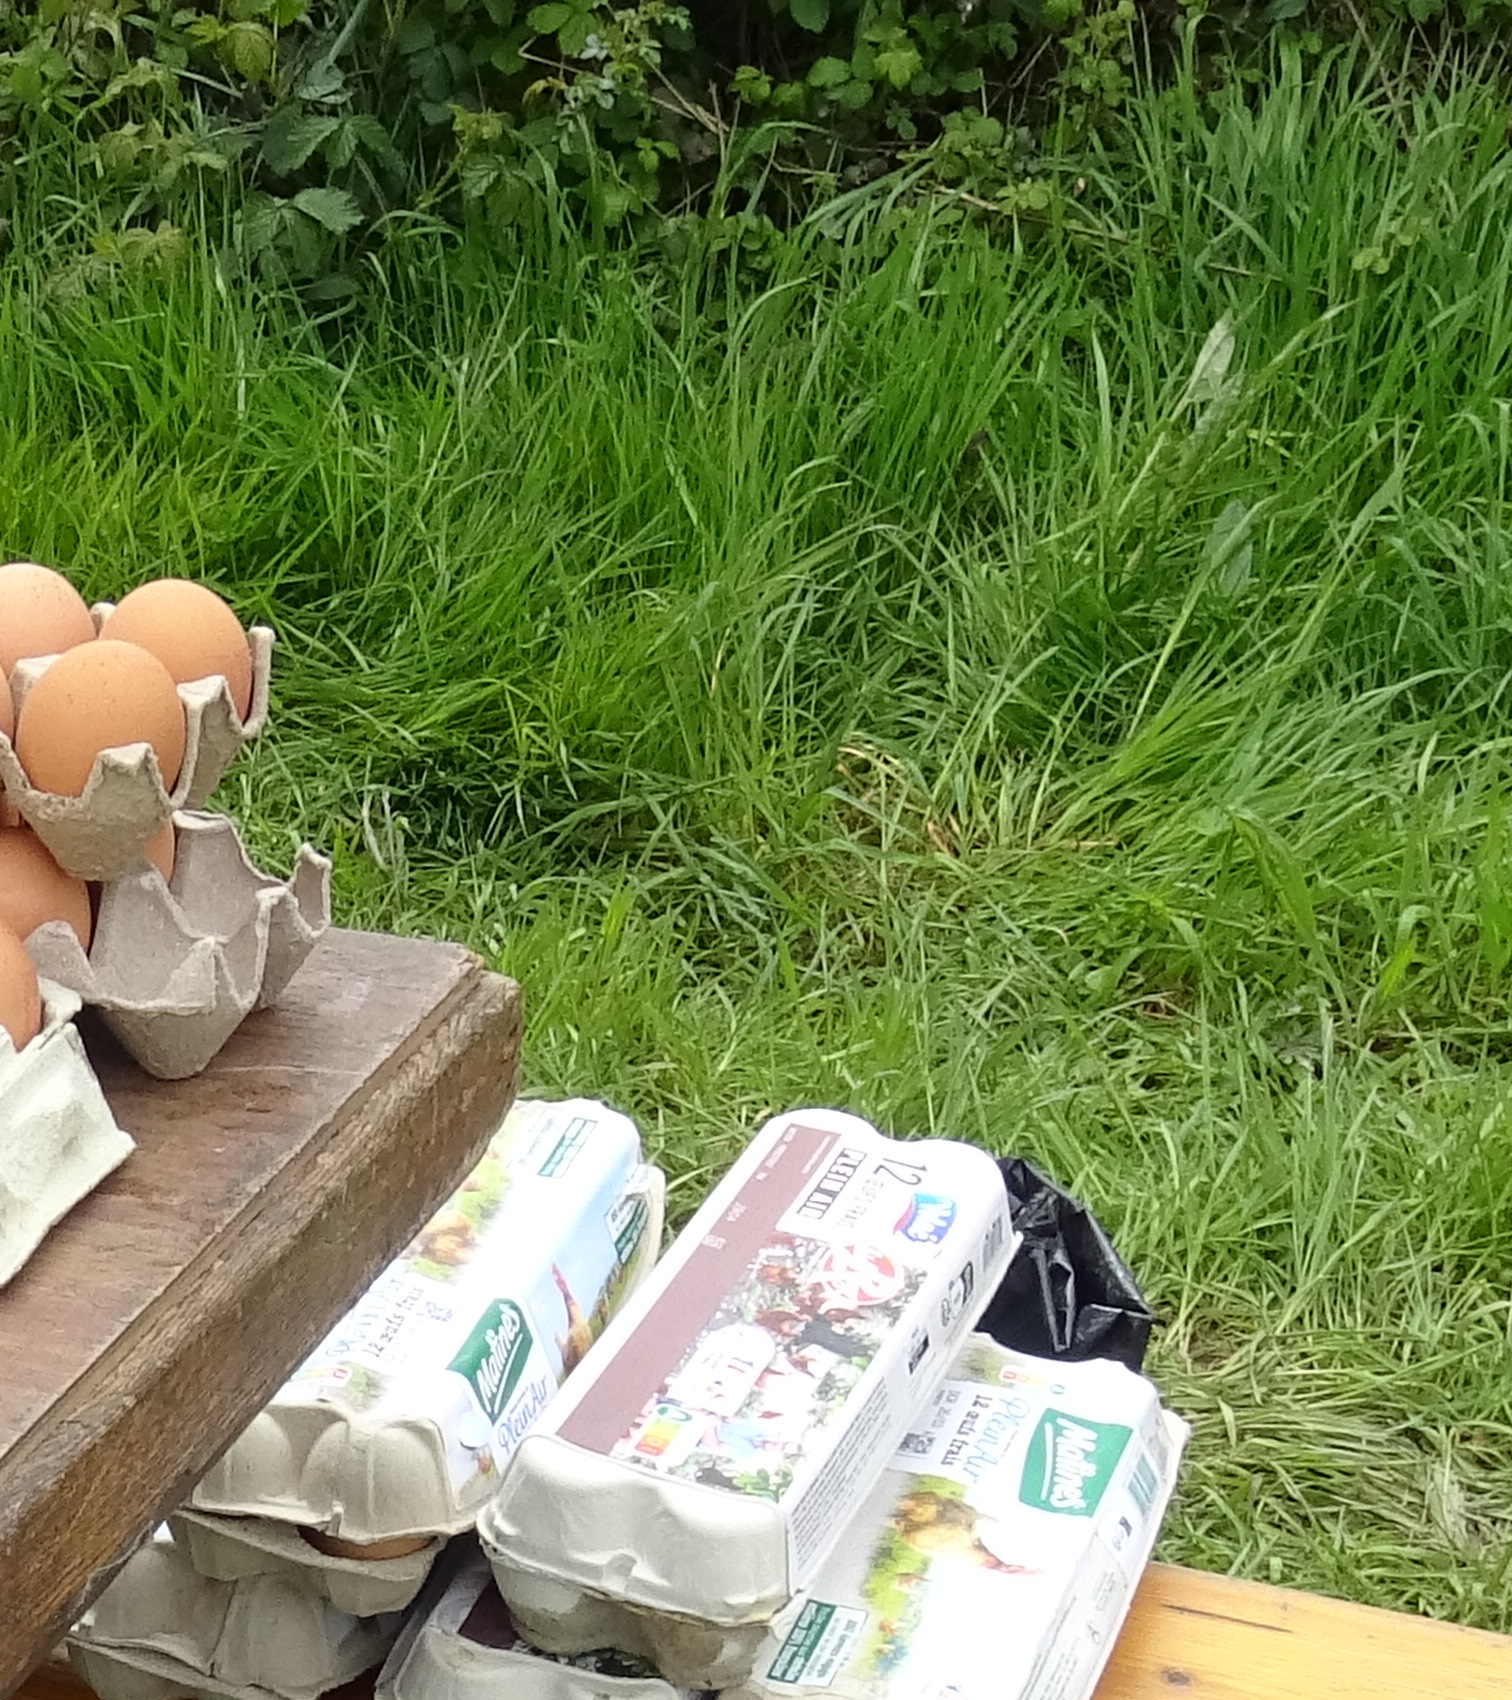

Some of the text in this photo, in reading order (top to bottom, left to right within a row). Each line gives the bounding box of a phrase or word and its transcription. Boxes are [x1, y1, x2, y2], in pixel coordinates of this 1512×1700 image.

[813, 1147, 867, 1192] PLEIN
[874, 1157, 928, 1187] 12
[795, 1187, 836, 1220] AIR
[477, 1303, 523, 1413] Matines
[975, 1394, 993, 1409] 12
[941, 1436, 967, 1467] frais
[1050, 1416, 1098, 1511] Matines
